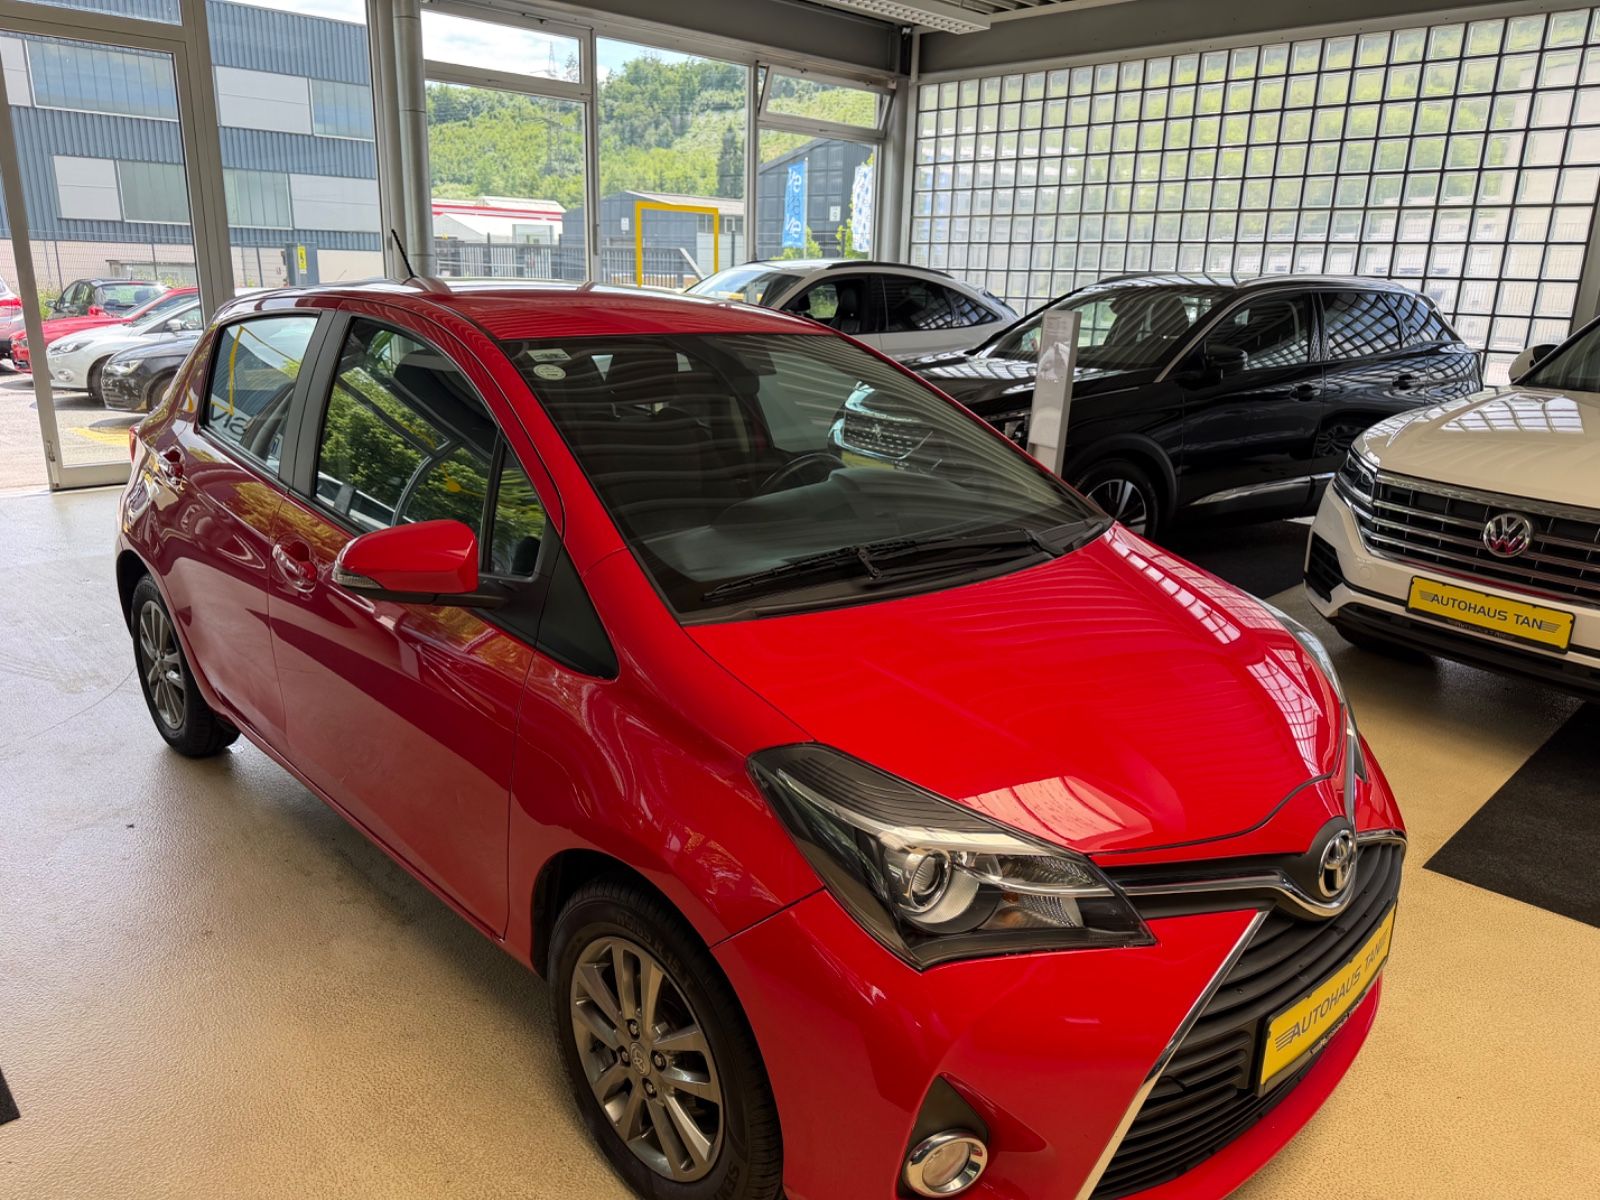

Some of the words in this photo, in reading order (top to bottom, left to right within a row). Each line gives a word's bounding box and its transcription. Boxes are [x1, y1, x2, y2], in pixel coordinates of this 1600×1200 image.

[1430, 594, 1508, 621] AUTOHAUS
[1513, 613, 1544, 631] TAN
[1289, 965, 1362, 1043] AUTOHAUS
